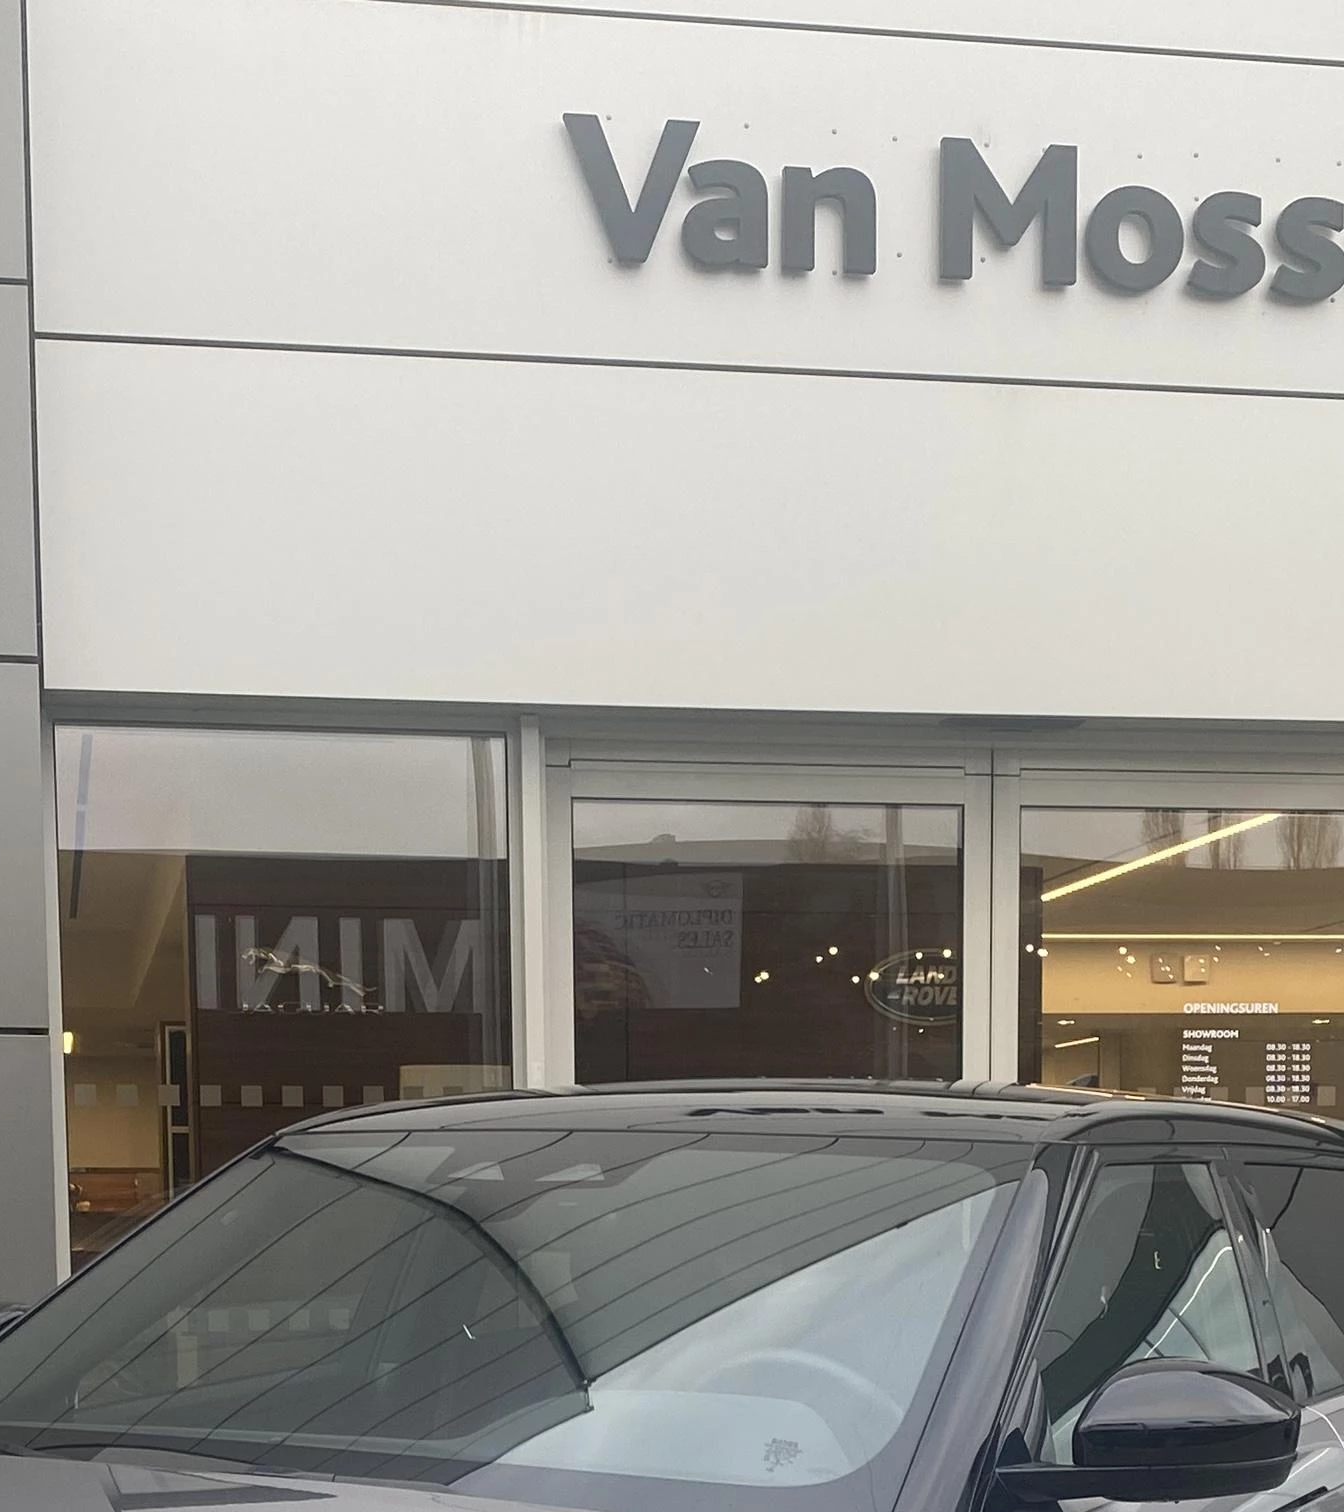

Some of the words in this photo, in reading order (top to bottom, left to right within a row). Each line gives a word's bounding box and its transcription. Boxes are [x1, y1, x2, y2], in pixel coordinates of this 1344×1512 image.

[562, 112, 877, 275] Van
[896, 965, 957, 984] LAND
[1183, 1002, 1278, 1014] OPENINGSUREN
[1182, 1029, 1239, 1039] SHOWROOM
